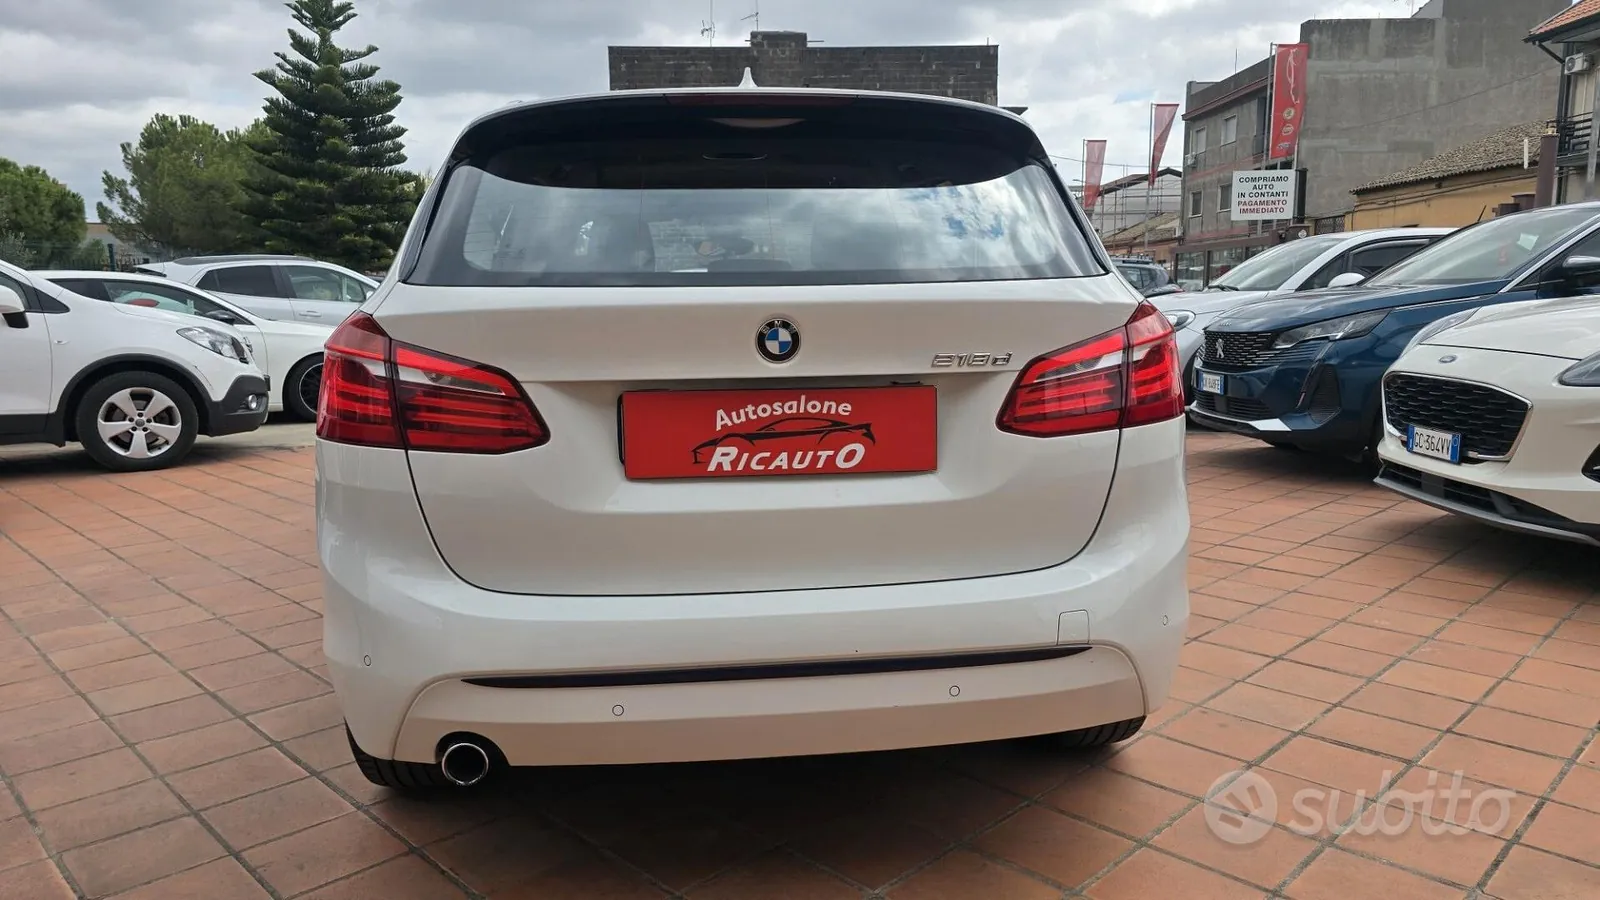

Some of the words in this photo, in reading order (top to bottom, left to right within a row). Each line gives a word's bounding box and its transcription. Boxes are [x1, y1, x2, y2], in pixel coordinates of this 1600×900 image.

[1238, 175, 1289, 183] COMPRIAMO
[1248, 190, 1289, 198] CONTANTI
[1237, 199, 1288, 207] PAGAMENTO
[931, 351, 1013, 368] 218d
[715, 395, 852, 431] Autosalone
[707, 442, 866, 472] RICAUTO
